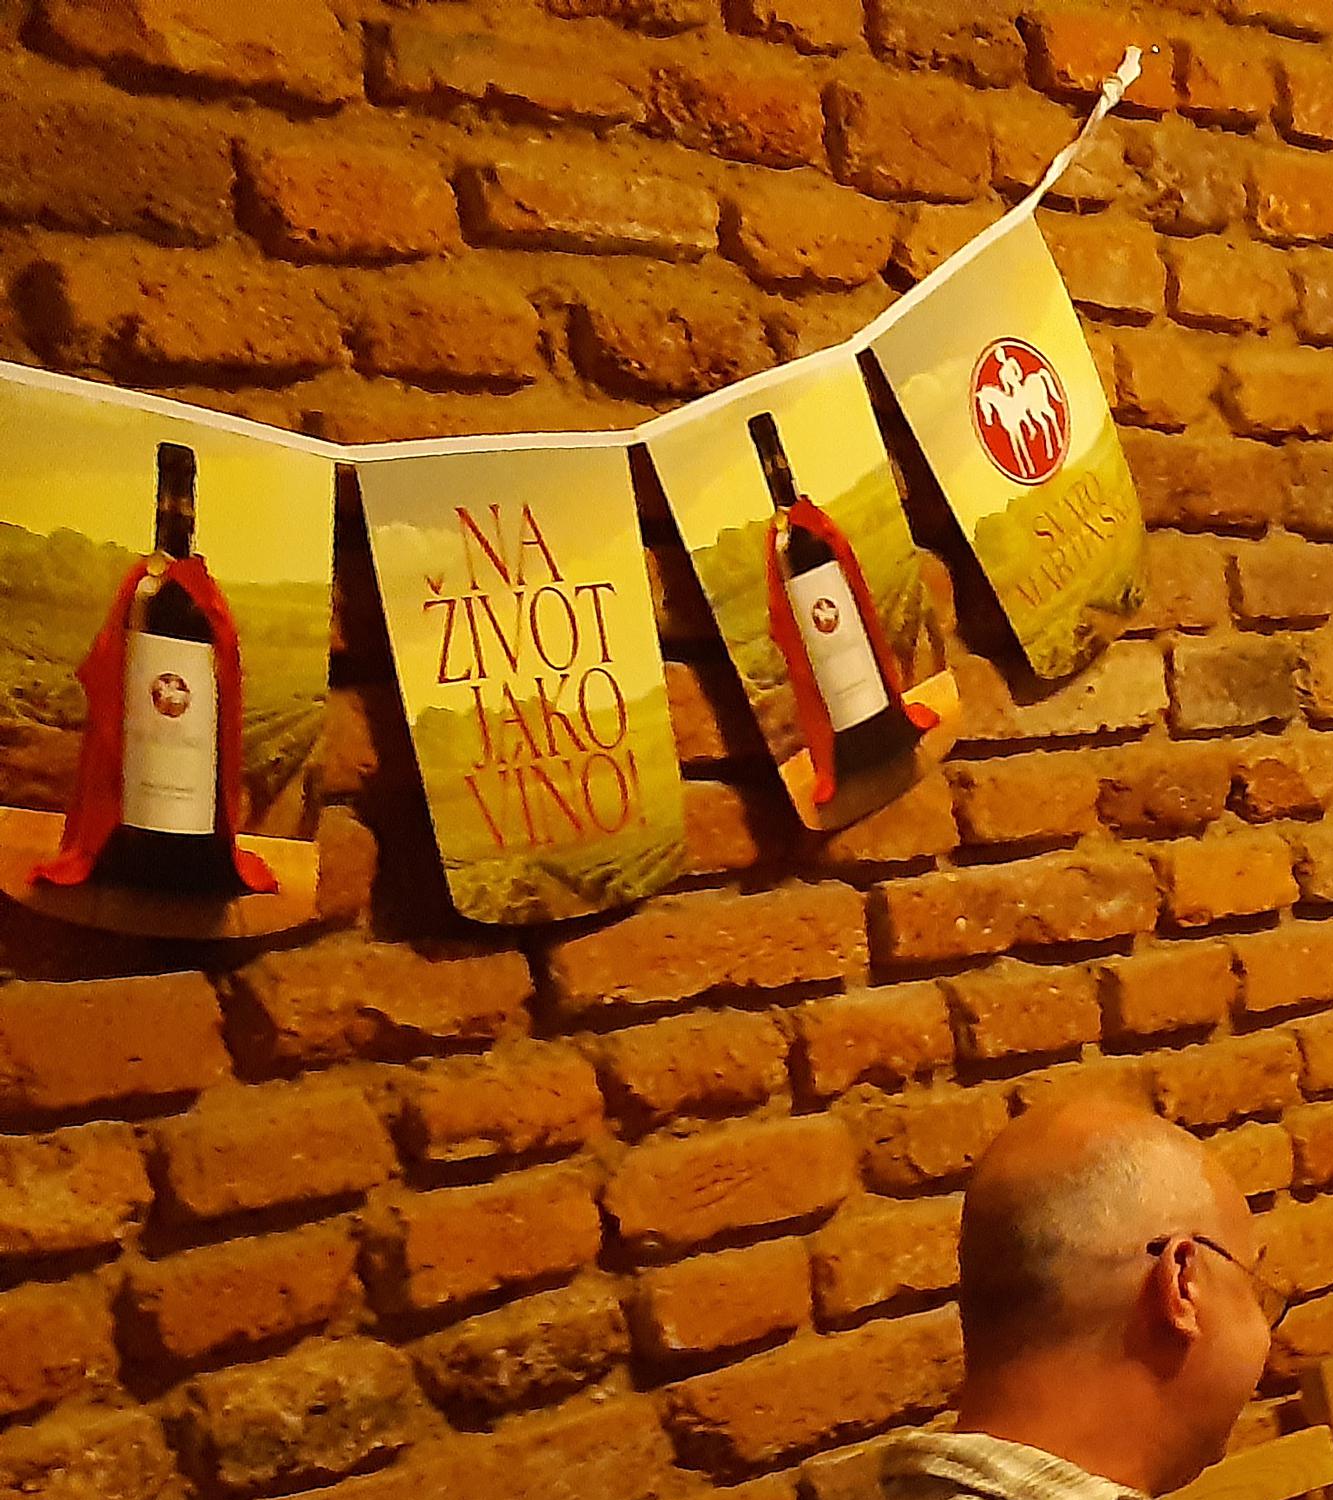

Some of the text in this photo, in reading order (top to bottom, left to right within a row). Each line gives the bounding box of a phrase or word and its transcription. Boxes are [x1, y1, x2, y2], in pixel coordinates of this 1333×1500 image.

[454, 502, 564, 591] NA
[422, 573, 617, 685] ŽIVOT
[470, 667, 629, 768] JAKO
